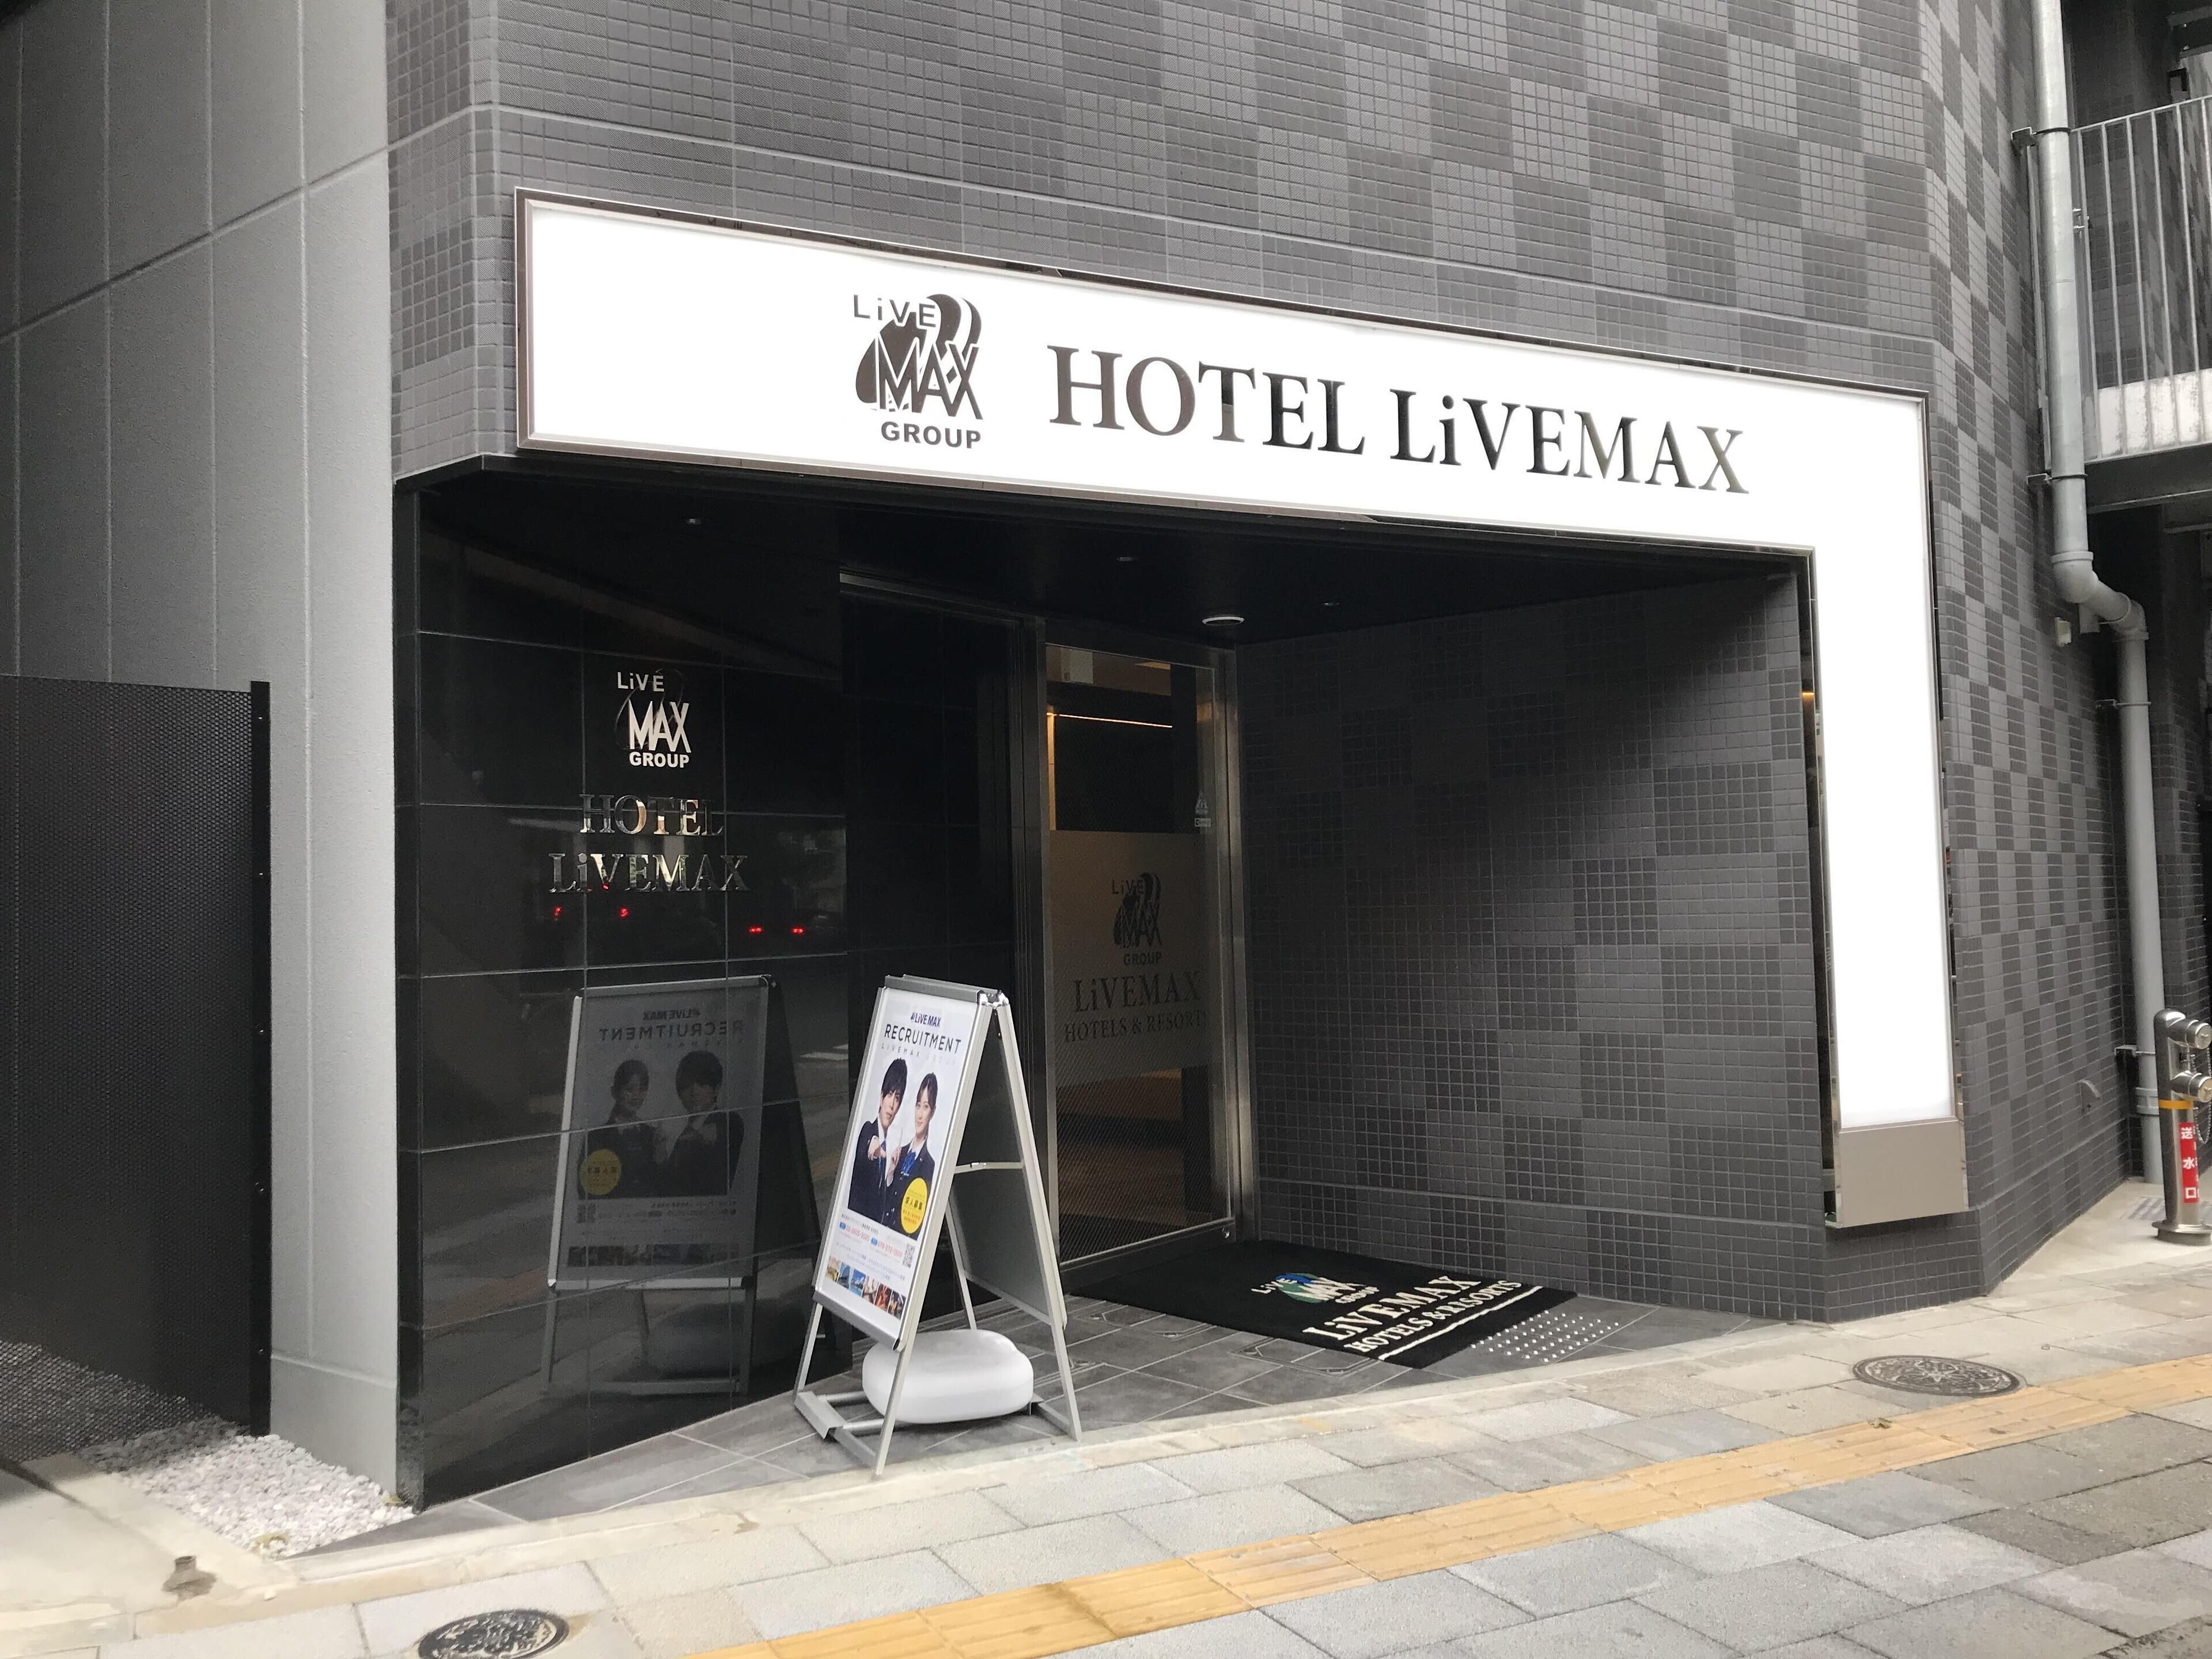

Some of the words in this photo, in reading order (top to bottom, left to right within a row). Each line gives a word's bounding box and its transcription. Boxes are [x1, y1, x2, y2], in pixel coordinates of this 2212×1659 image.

[853, 294, 938, 328] LiVE
[877, 334, 983, 421] MAX
[880, 421, 982, 449] GROUP
[1047, 344, 1366, 455] HOTEL
[1389, 388, 1749, 494] LiVEMAX
[617, 671, 665, 692] LiVE
[628, 698, 691, 753] MAX
[629, 751, 690, 768] GROUP
[579, 794, 724, 836] HOTEL
[548, 853, 748, 893] LiVEMAX
[1123, 951, 1162, 966] GROUP
[1073, 971, 1202, 1012] LiVEMAX
[884, 1024, 961, 1054] RECRUITMENT
[1065, 1018, 1127, 1042] HOTELS
[1132, 1017, 1142, 1035] &
[2180, 1127, 2197, 1199] 送水口
[1302, 1275, 1482, 1341] LiVEMAX
[1435, 1279, 1522, 1314] RESORTS
[1421, 1310, 1452, 1320] &
[1343, 1317, 1434, 1353] HOTELS
